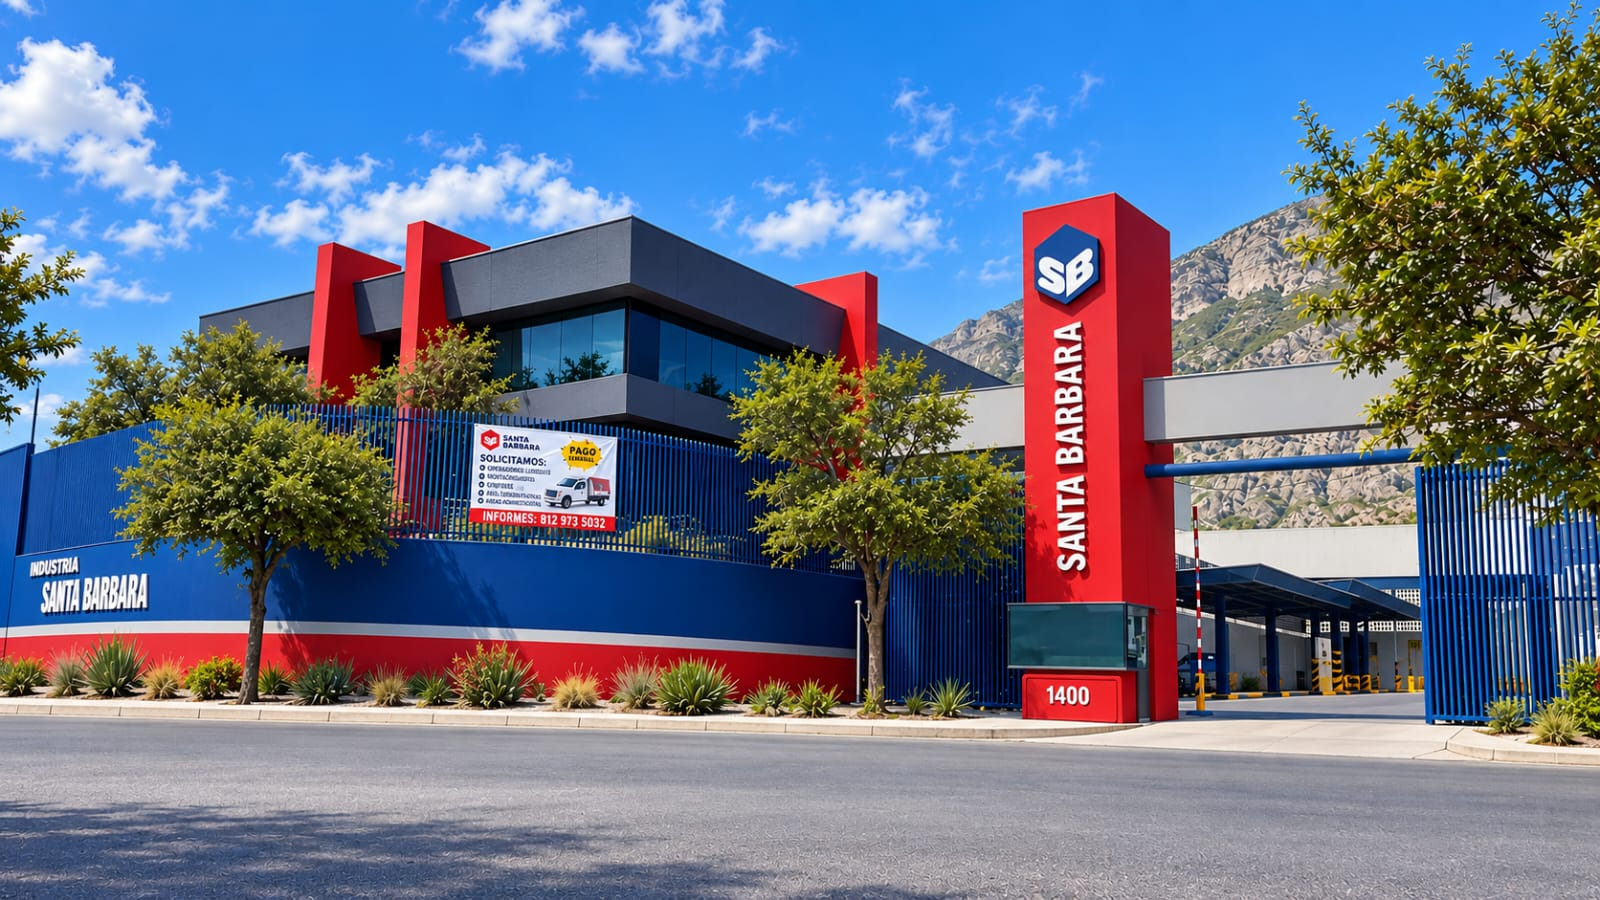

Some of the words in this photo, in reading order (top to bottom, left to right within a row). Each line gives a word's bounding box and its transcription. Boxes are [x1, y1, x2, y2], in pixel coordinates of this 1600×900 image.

[1037, 247, 1094, 298] SB
[1053, 320, 1085, 465] BARBARA
[502, 442, 541, 451] BARBARA
[503, 434, 530, 443] SANTA
[480, 453, 547, 467] SOLICITAMOS:
[569, 446, 597, 456] PAGO
[482, 510, 537, 524] INFORMES:
[540, 514, 558, 526] 812
[560, 516, 578, 527] 973
[581, 517, 606, 529] 5032
[1056, 474, 1087, 572] SANTA
[30, 556, 79, 577] INDUSTRIA
[40, 578, 80, 614] SANTA
[82, 573, 148, 611] BARBARA
[1046, 685, 1090, 705] 1400
